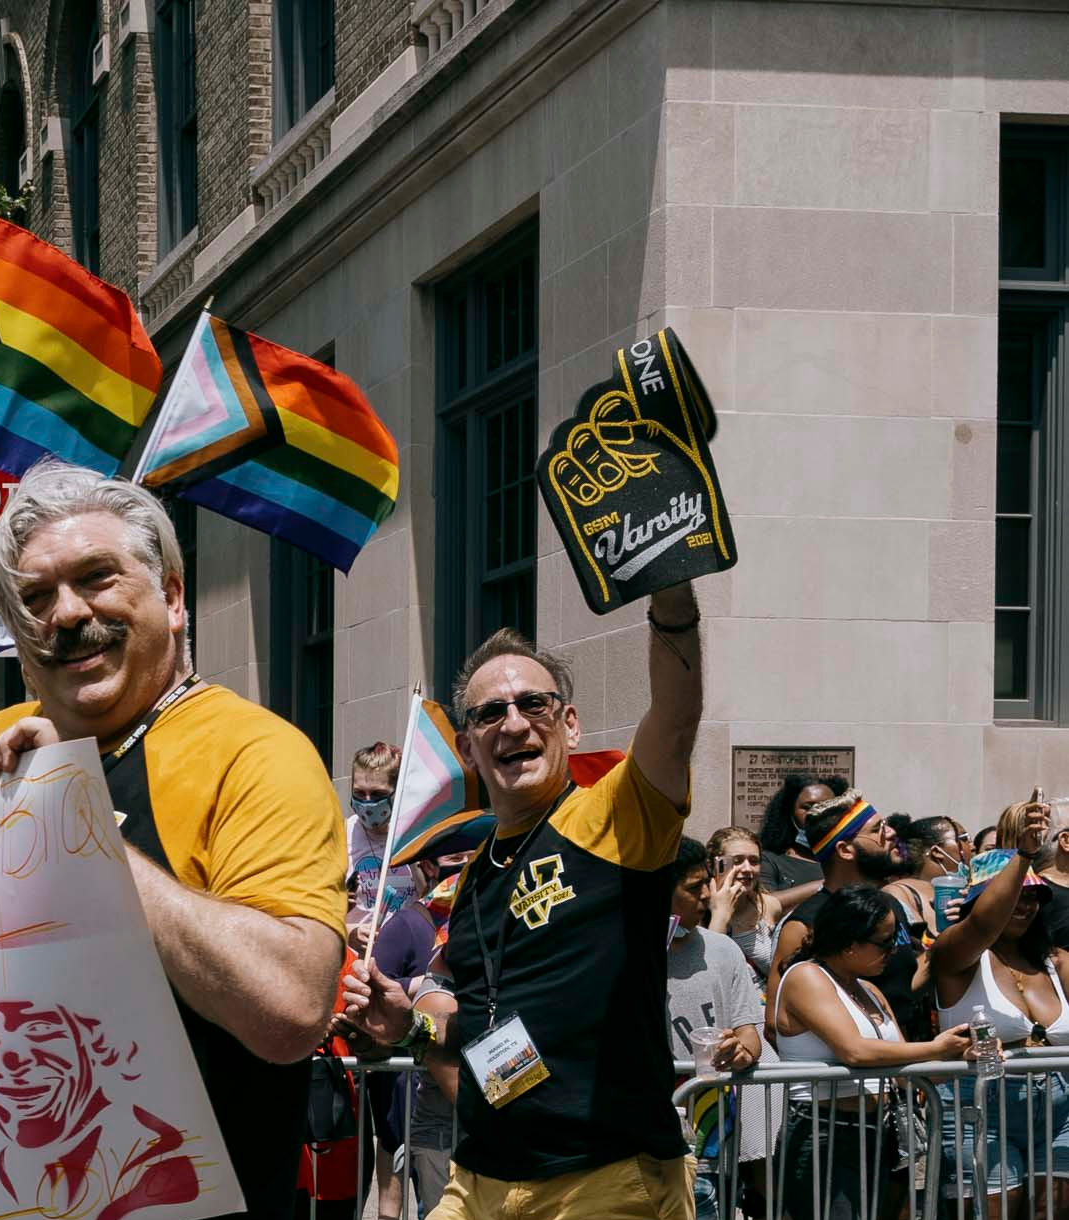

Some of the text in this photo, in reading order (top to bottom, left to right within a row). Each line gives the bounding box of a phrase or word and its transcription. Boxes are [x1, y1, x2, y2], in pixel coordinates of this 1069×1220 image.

[630, 338, 666, 396] ONE
[583, 511, 622, 535] GSM
[594, 491, 707, 566] Varsity
[685, 532, 713, 549] 2021
[514, 883, 557, 913] VARSITY
